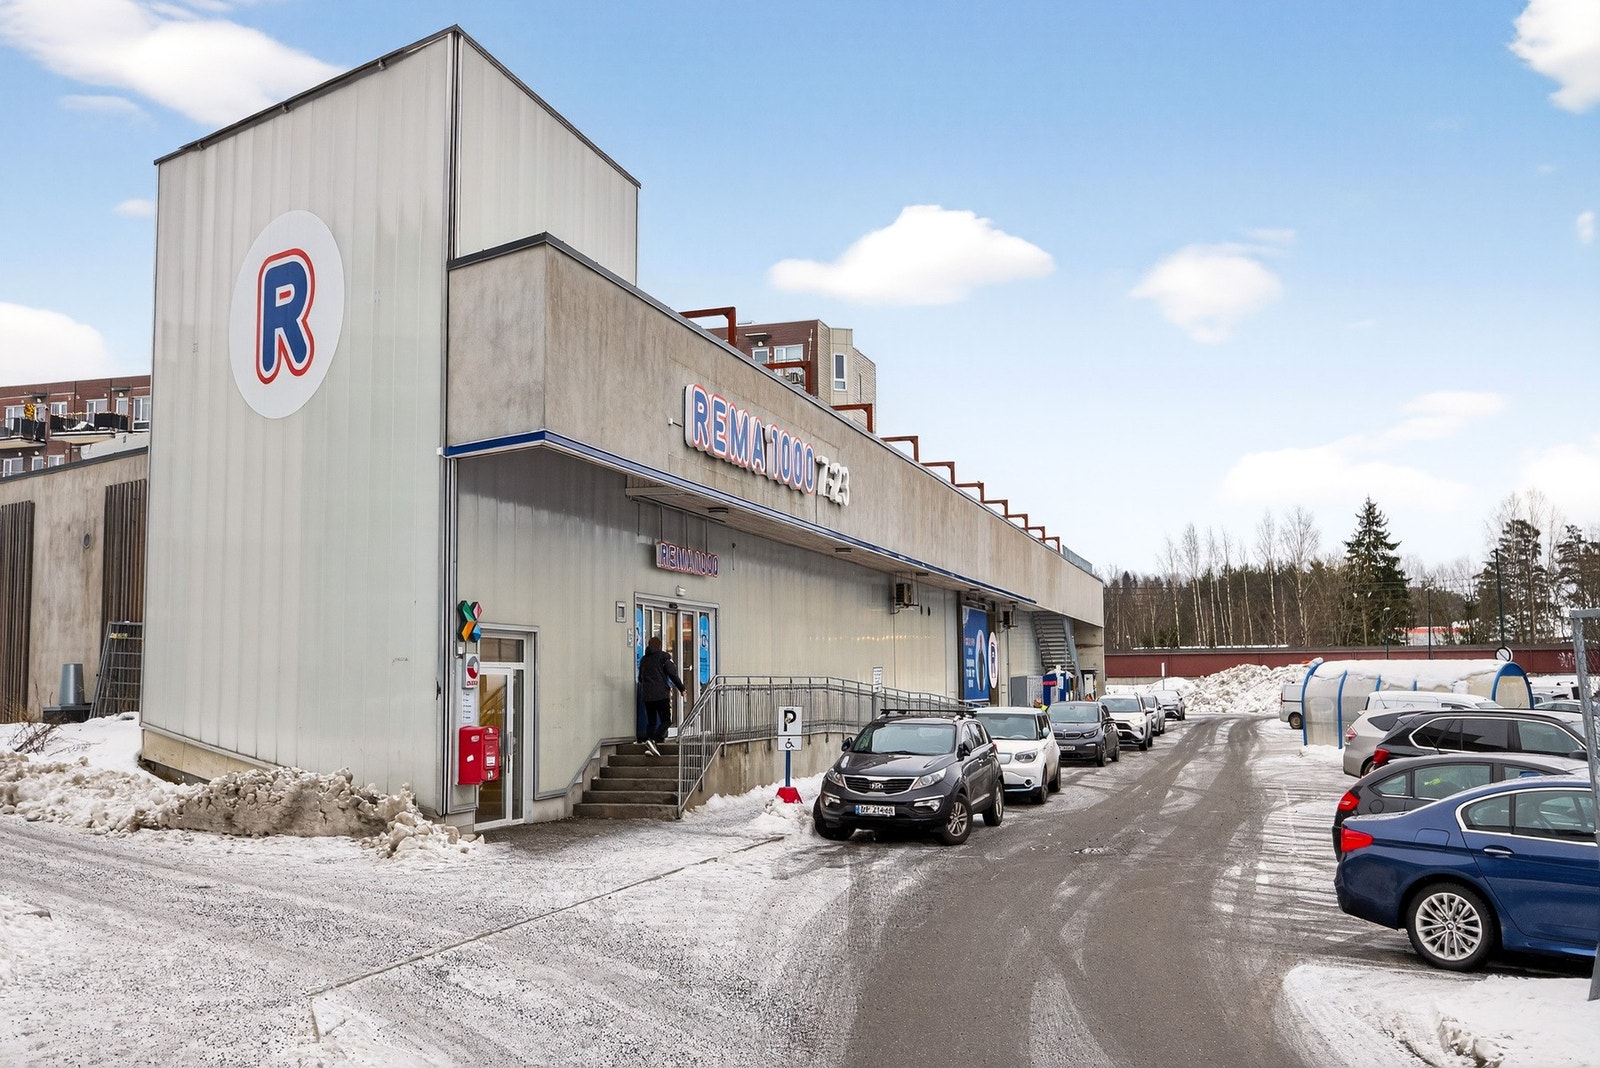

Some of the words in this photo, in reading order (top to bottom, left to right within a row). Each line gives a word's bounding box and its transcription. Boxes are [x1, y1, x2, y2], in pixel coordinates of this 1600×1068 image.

[256, 248, 315, 384] R
[690, 383, 766, 475] REMA
[767, 423, 815, 495] 1000
[659, 541, 696, 573] REMA
[783, 709, 797, 732] P
